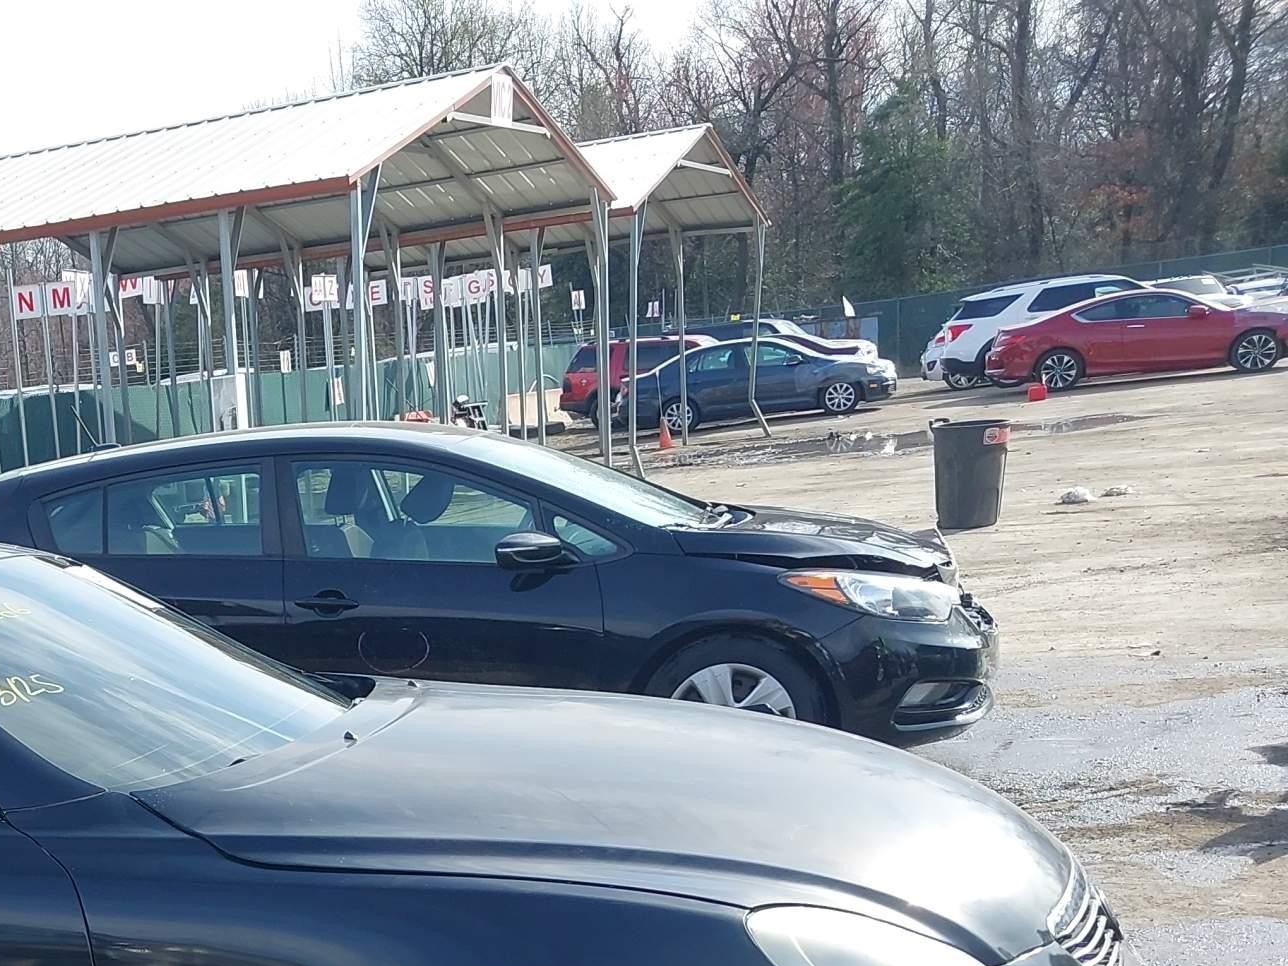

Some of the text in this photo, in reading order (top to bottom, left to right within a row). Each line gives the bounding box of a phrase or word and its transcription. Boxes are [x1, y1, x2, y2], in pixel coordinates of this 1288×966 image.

[371, 285, 381, 301] E
[468, 280, 481, 294] G
[18, 292, 34, 313] N
[52, 286, 71, 309] M
